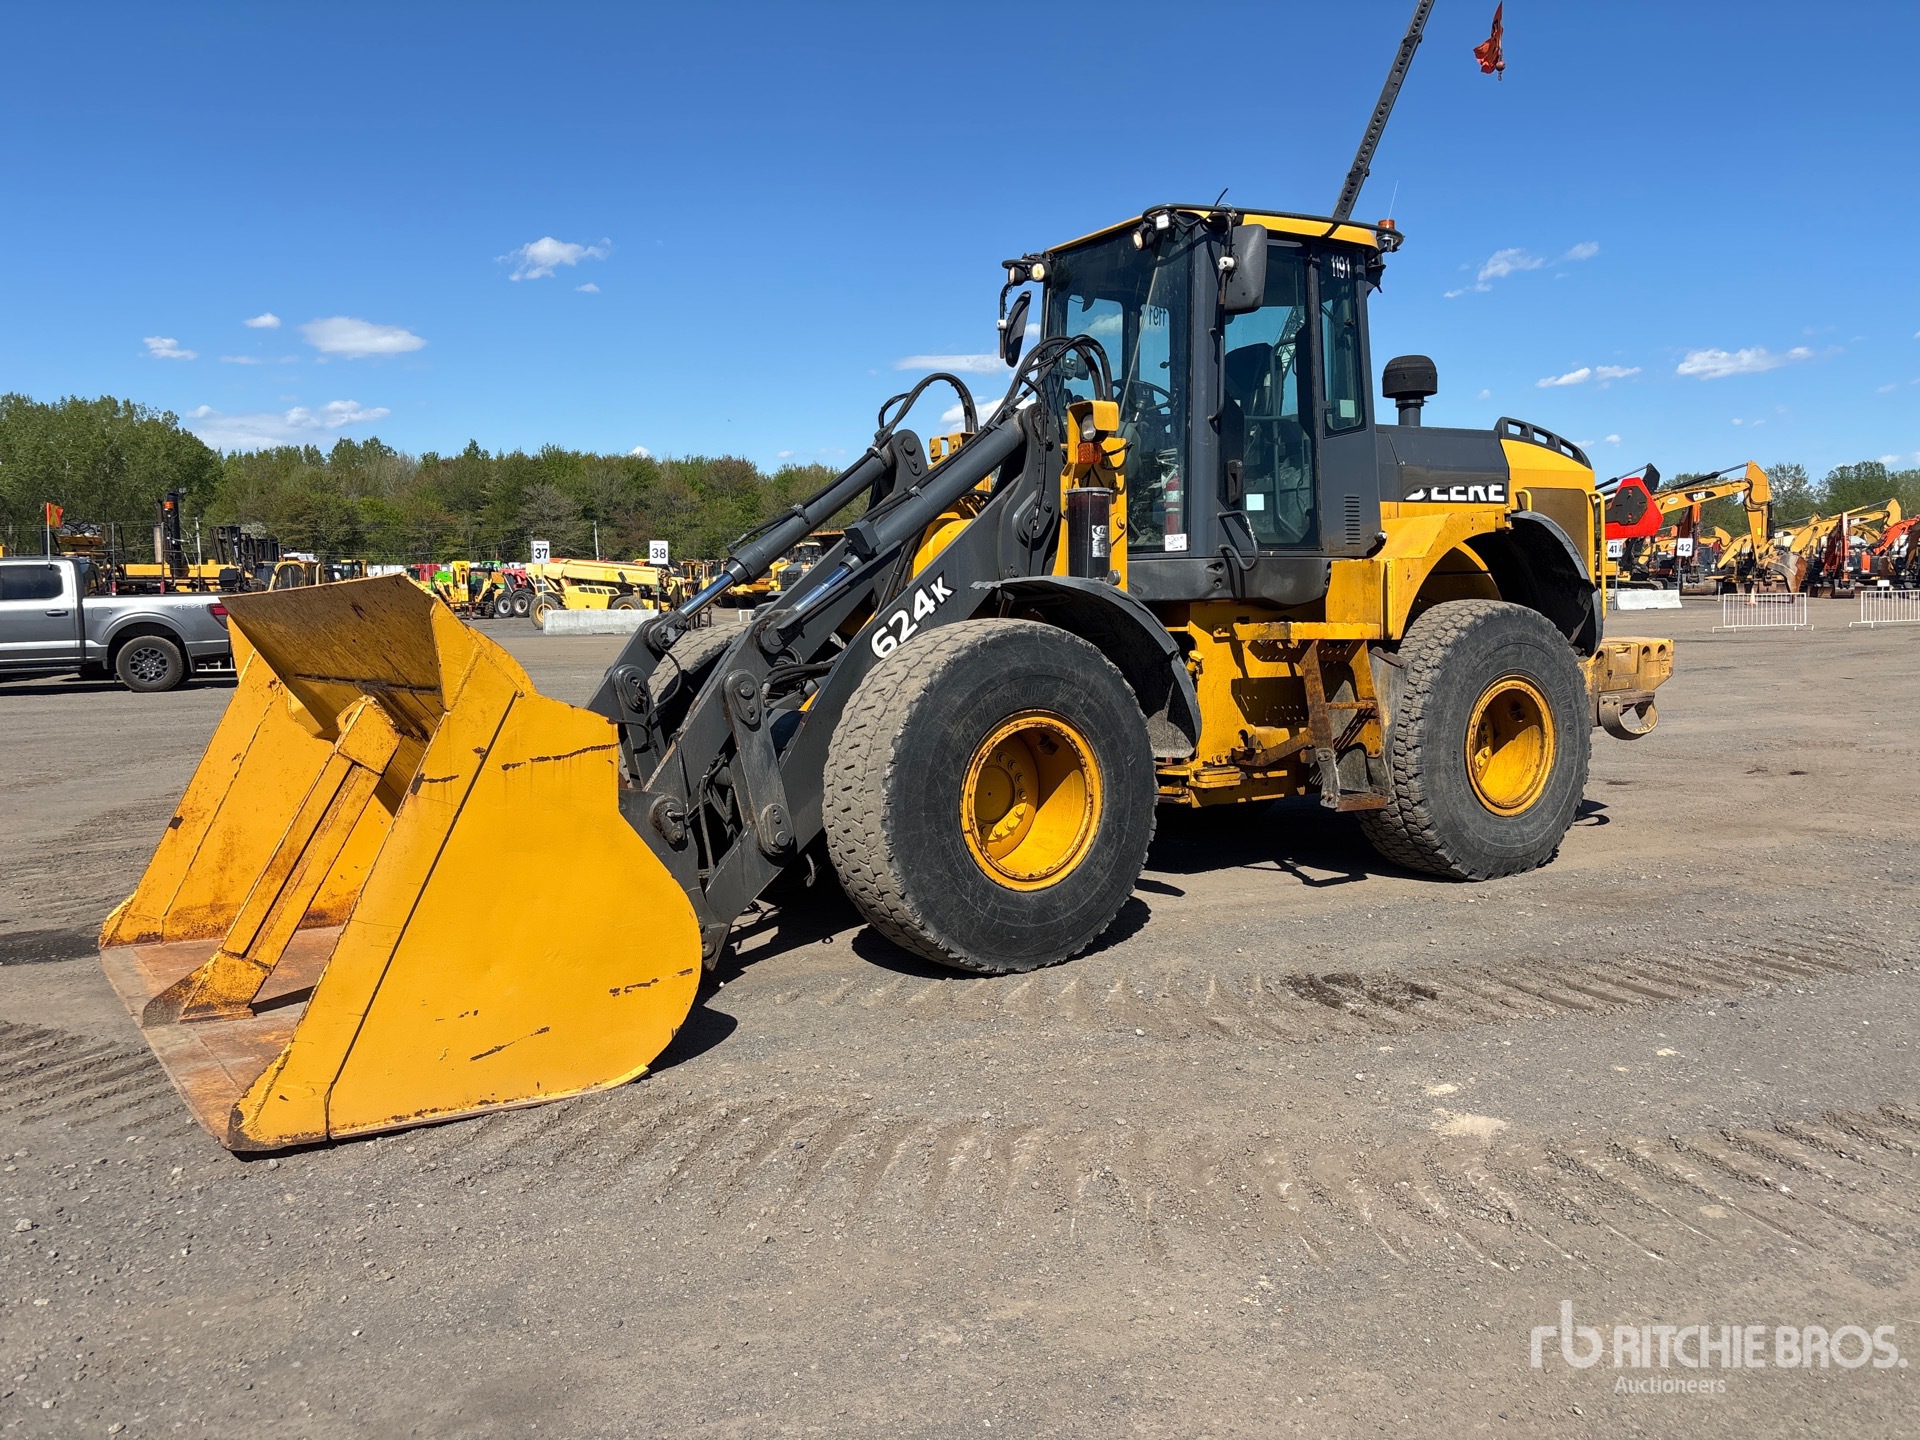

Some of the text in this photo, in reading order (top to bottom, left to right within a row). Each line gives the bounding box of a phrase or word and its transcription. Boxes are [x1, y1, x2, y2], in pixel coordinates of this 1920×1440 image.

[1330, 254, 1351, 279] 1191
[1692, 491, 1706, 502] CAT
[534, 547, 548, 560] 37
[651, 547, 667, 559] 38
[1608, 546, 1618, 556] 41
[1678, 543, 1692, 552] 42
[871, 576, 954, 659] 624K
